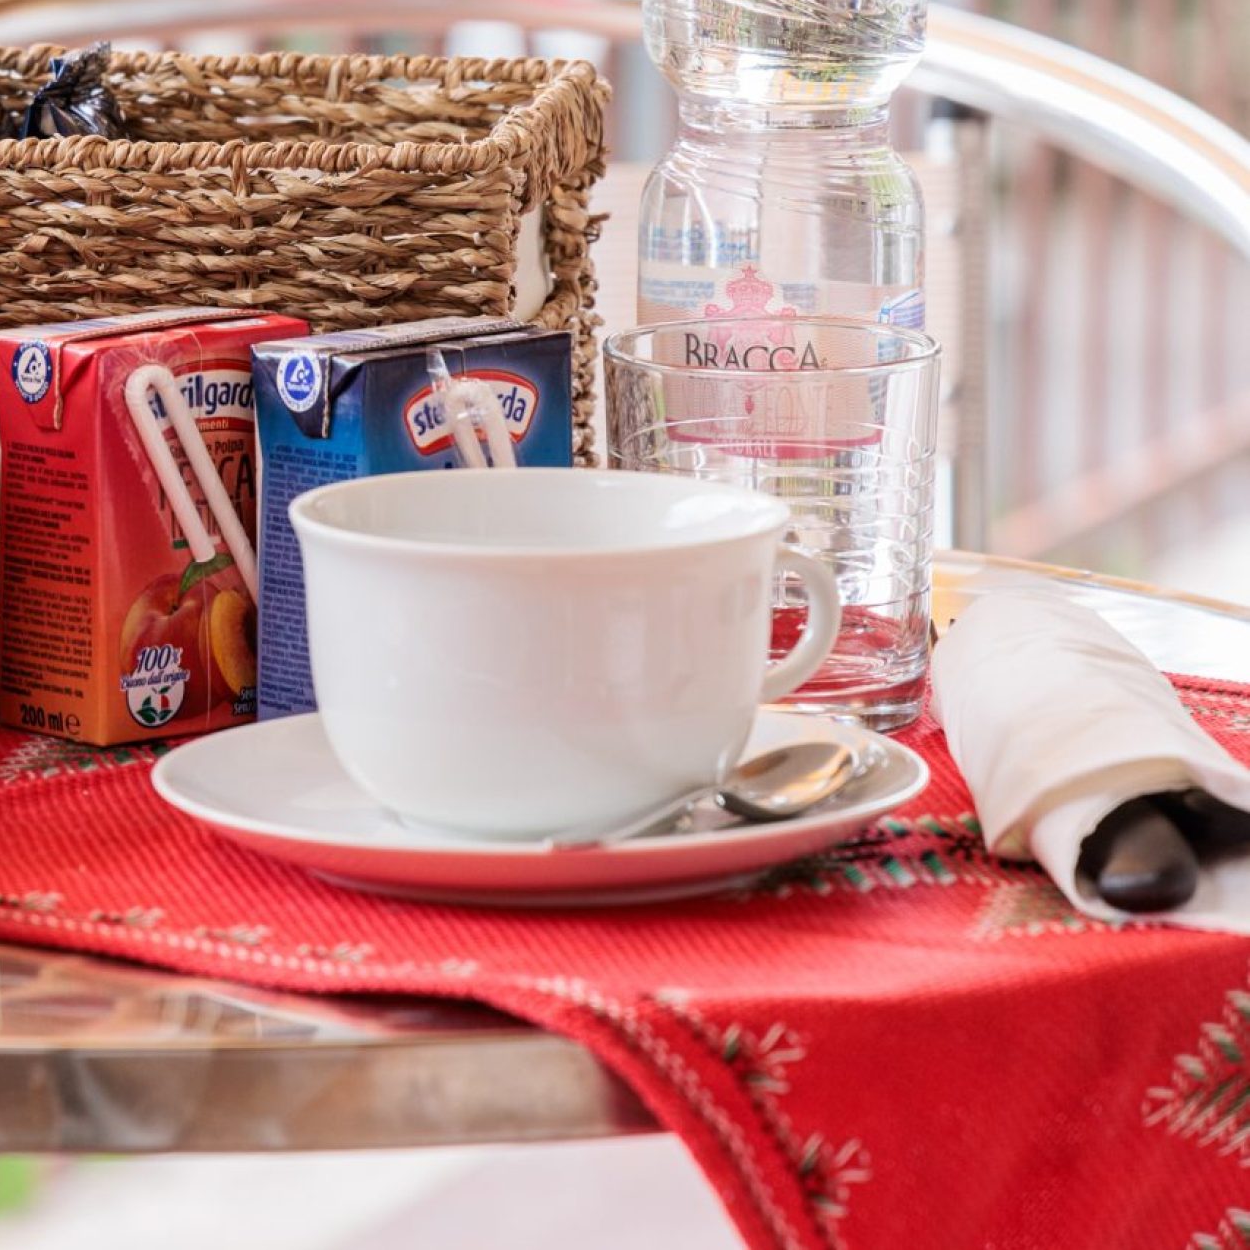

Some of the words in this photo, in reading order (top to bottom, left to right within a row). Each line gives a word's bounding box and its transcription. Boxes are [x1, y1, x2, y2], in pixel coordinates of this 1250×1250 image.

[684, 332, 820, 371] BRACCA
[199, 418, 230, 431] menti
[20, 703, 45, 729] 200
[48, 711, 63, 732] ml
